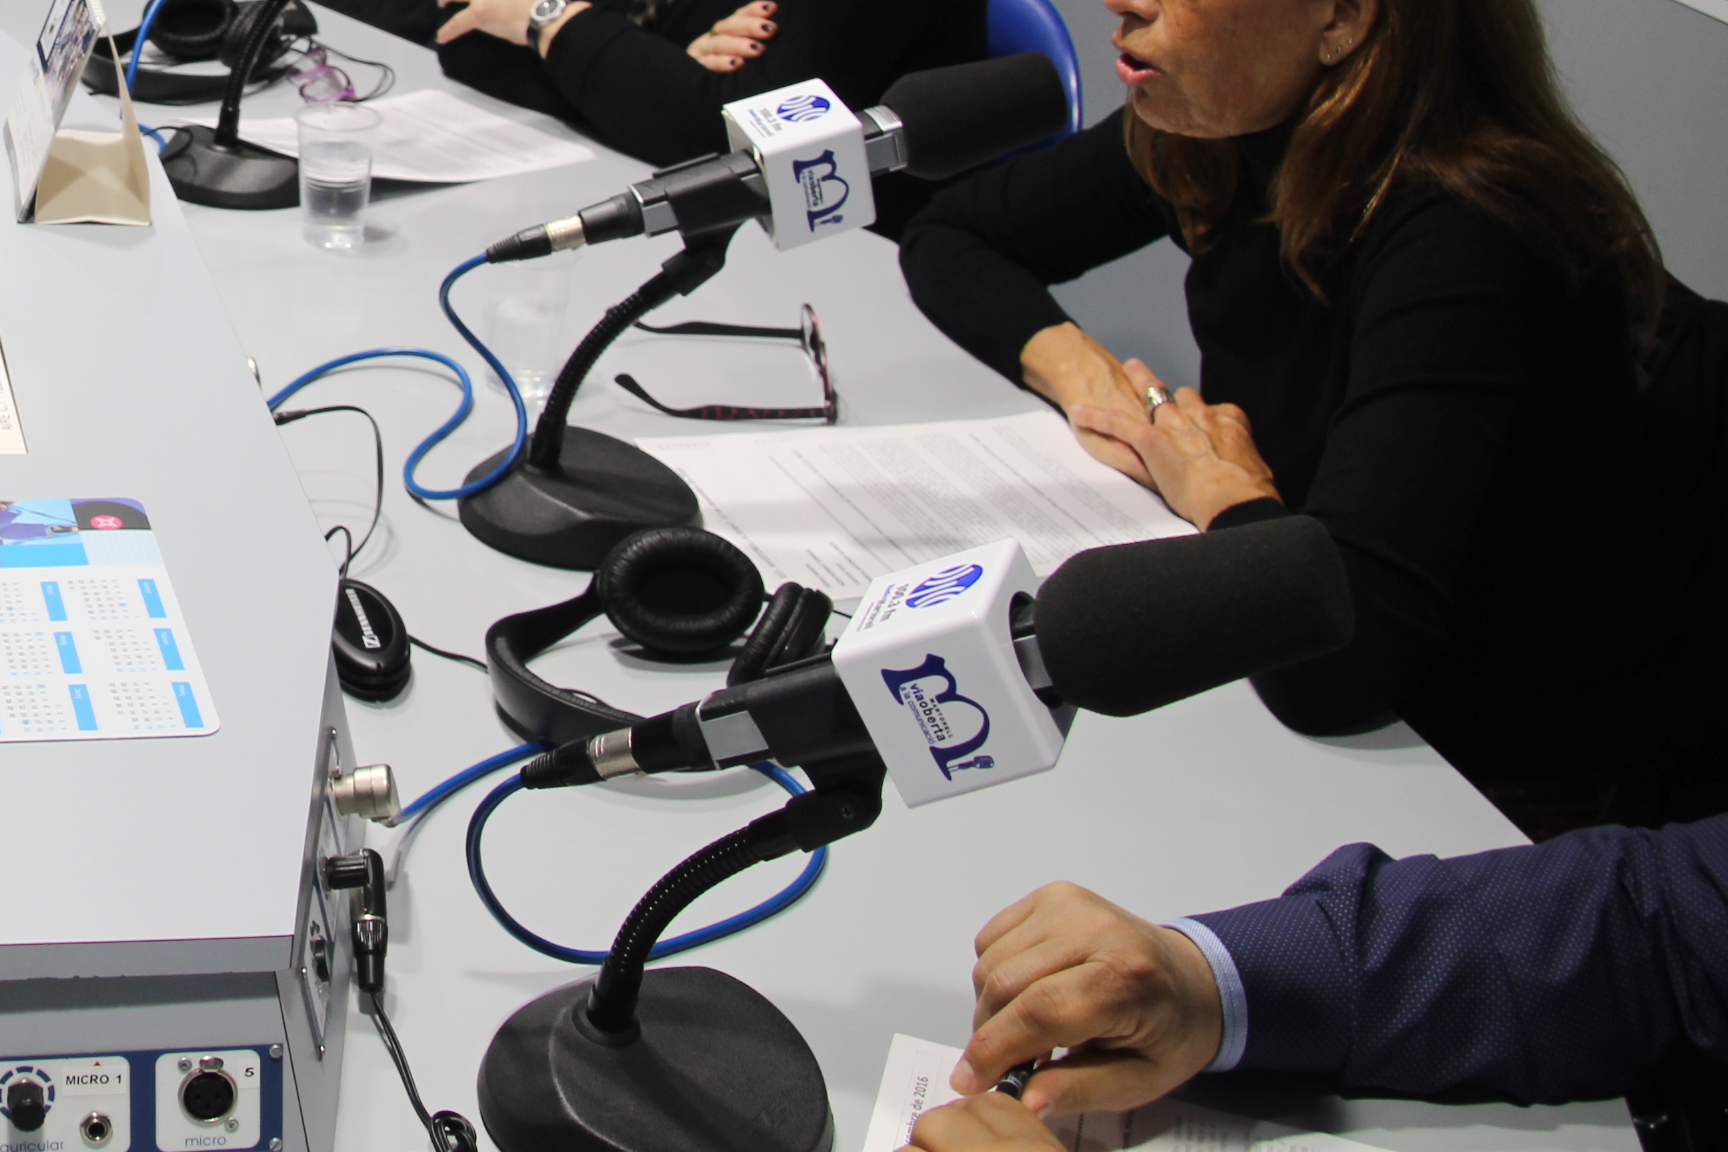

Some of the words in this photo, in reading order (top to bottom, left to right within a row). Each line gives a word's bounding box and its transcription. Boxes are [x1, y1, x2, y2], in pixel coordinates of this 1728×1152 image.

[910, 683, 946, 742] viaoberta
[244, 1066, 255, 1078] 5
[65, 1074, 110, 1086] MICRO
[115, 1074, 122, 1085] 1
[913, 1076, 929, 1098] 2016
[910, 1098, 924, 1111] de
[0, 1140, 65, 1152] auricular
[185, 1135, 227, 1147] micro
